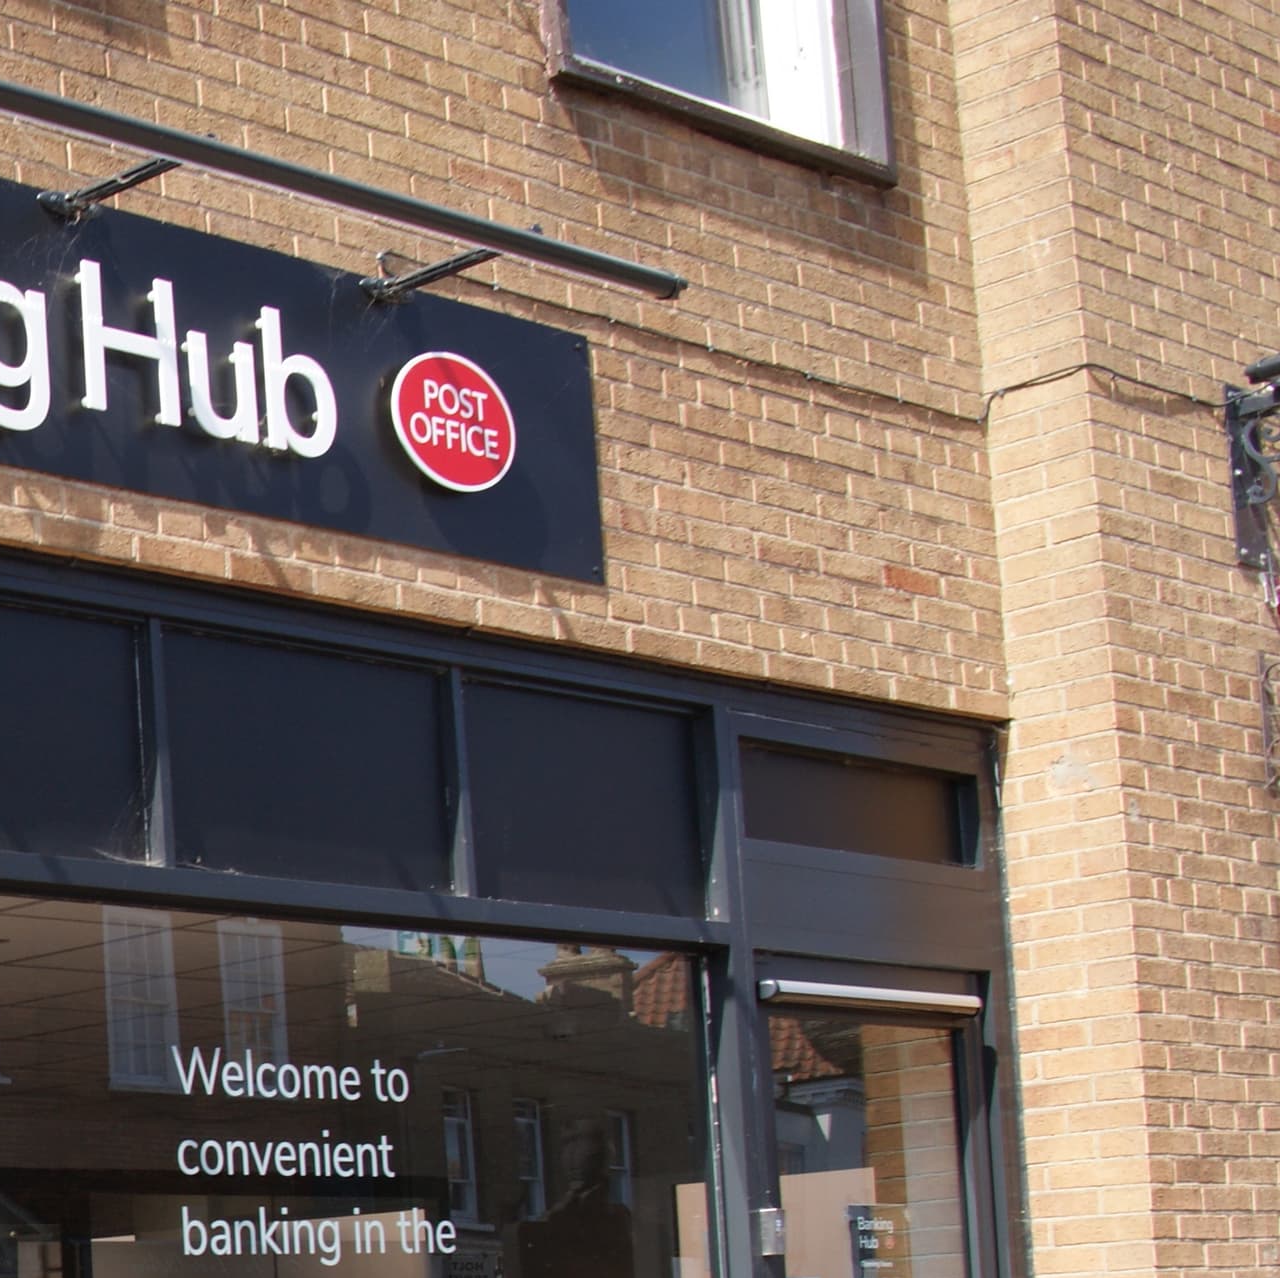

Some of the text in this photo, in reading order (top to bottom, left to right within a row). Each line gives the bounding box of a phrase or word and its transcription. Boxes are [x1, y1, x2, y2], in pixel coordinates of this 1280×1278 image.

[75, 258, 337, 459] Hub
[422, 380, 488, 418] POST
[409, 410, 500, 461] OFFICE
[171, 1045, 409, 1102] Welcome to
[177, 1130, 395, 1178] convenient
[182, 1207, 456, 1265] banking in the
